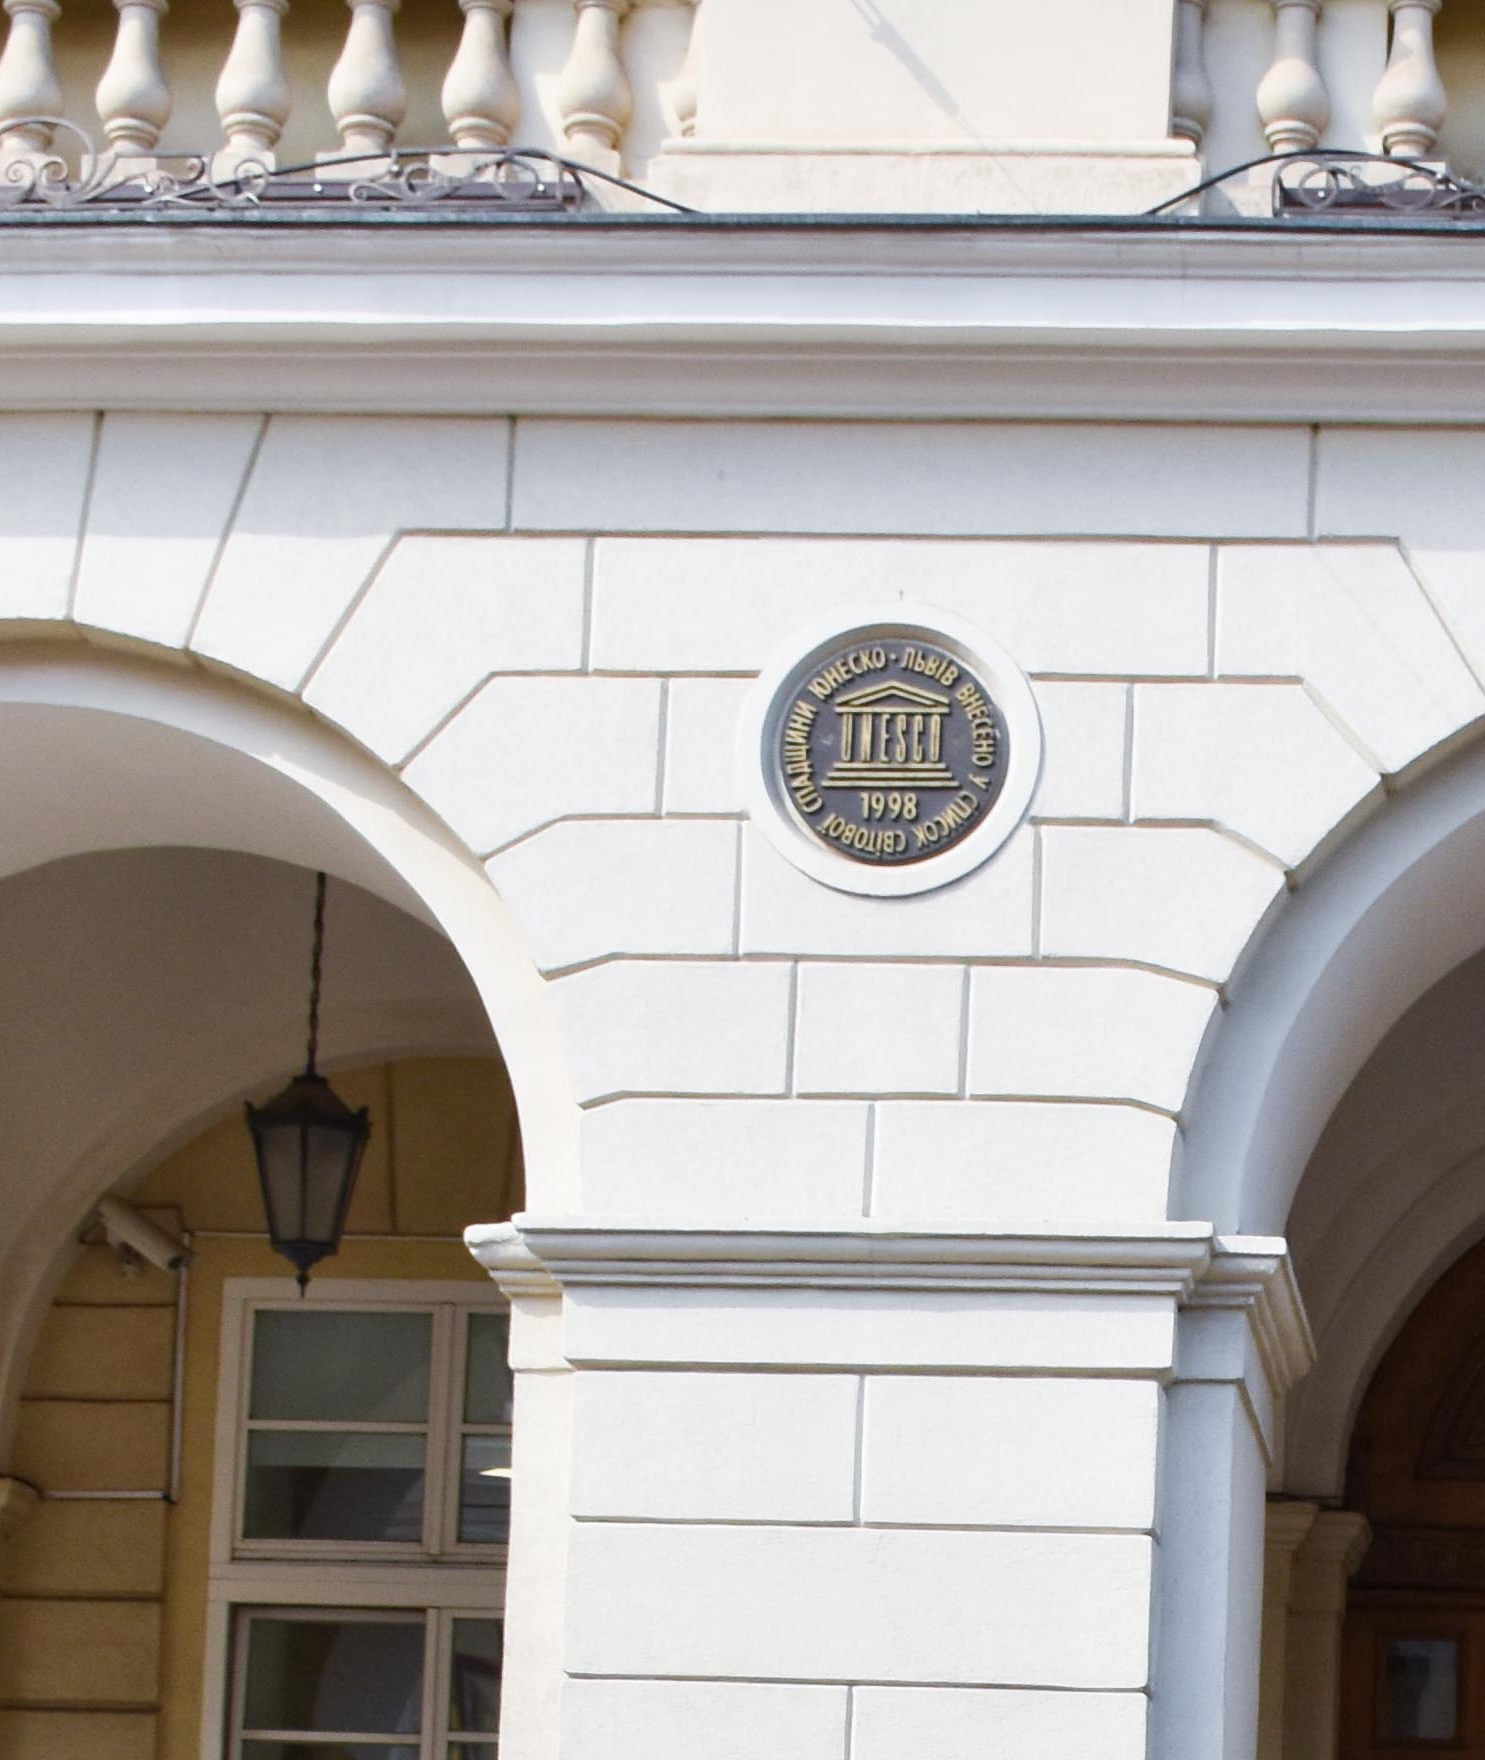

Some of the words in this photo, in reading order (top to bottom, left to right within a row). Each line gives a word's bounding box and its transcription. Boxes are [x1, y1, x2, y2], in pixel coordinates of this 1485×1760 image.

[808, 647, 886, 700] ЮНЕСКО
[901, 647, 959, 686] ЛЬВІВ
[841, 713, 942, 763] UNESCO
[956, 684, 995, 767] ВНЕСЕНО
[784, 701, 822, 813] СПАДЩИНИ
[969, 772, 991, 790] У
[860, 792, 917, 820] 1998
[913, 790, 979, 847] СПИСОК
[817, 812, 907, 856] СВІТОВОЇ
